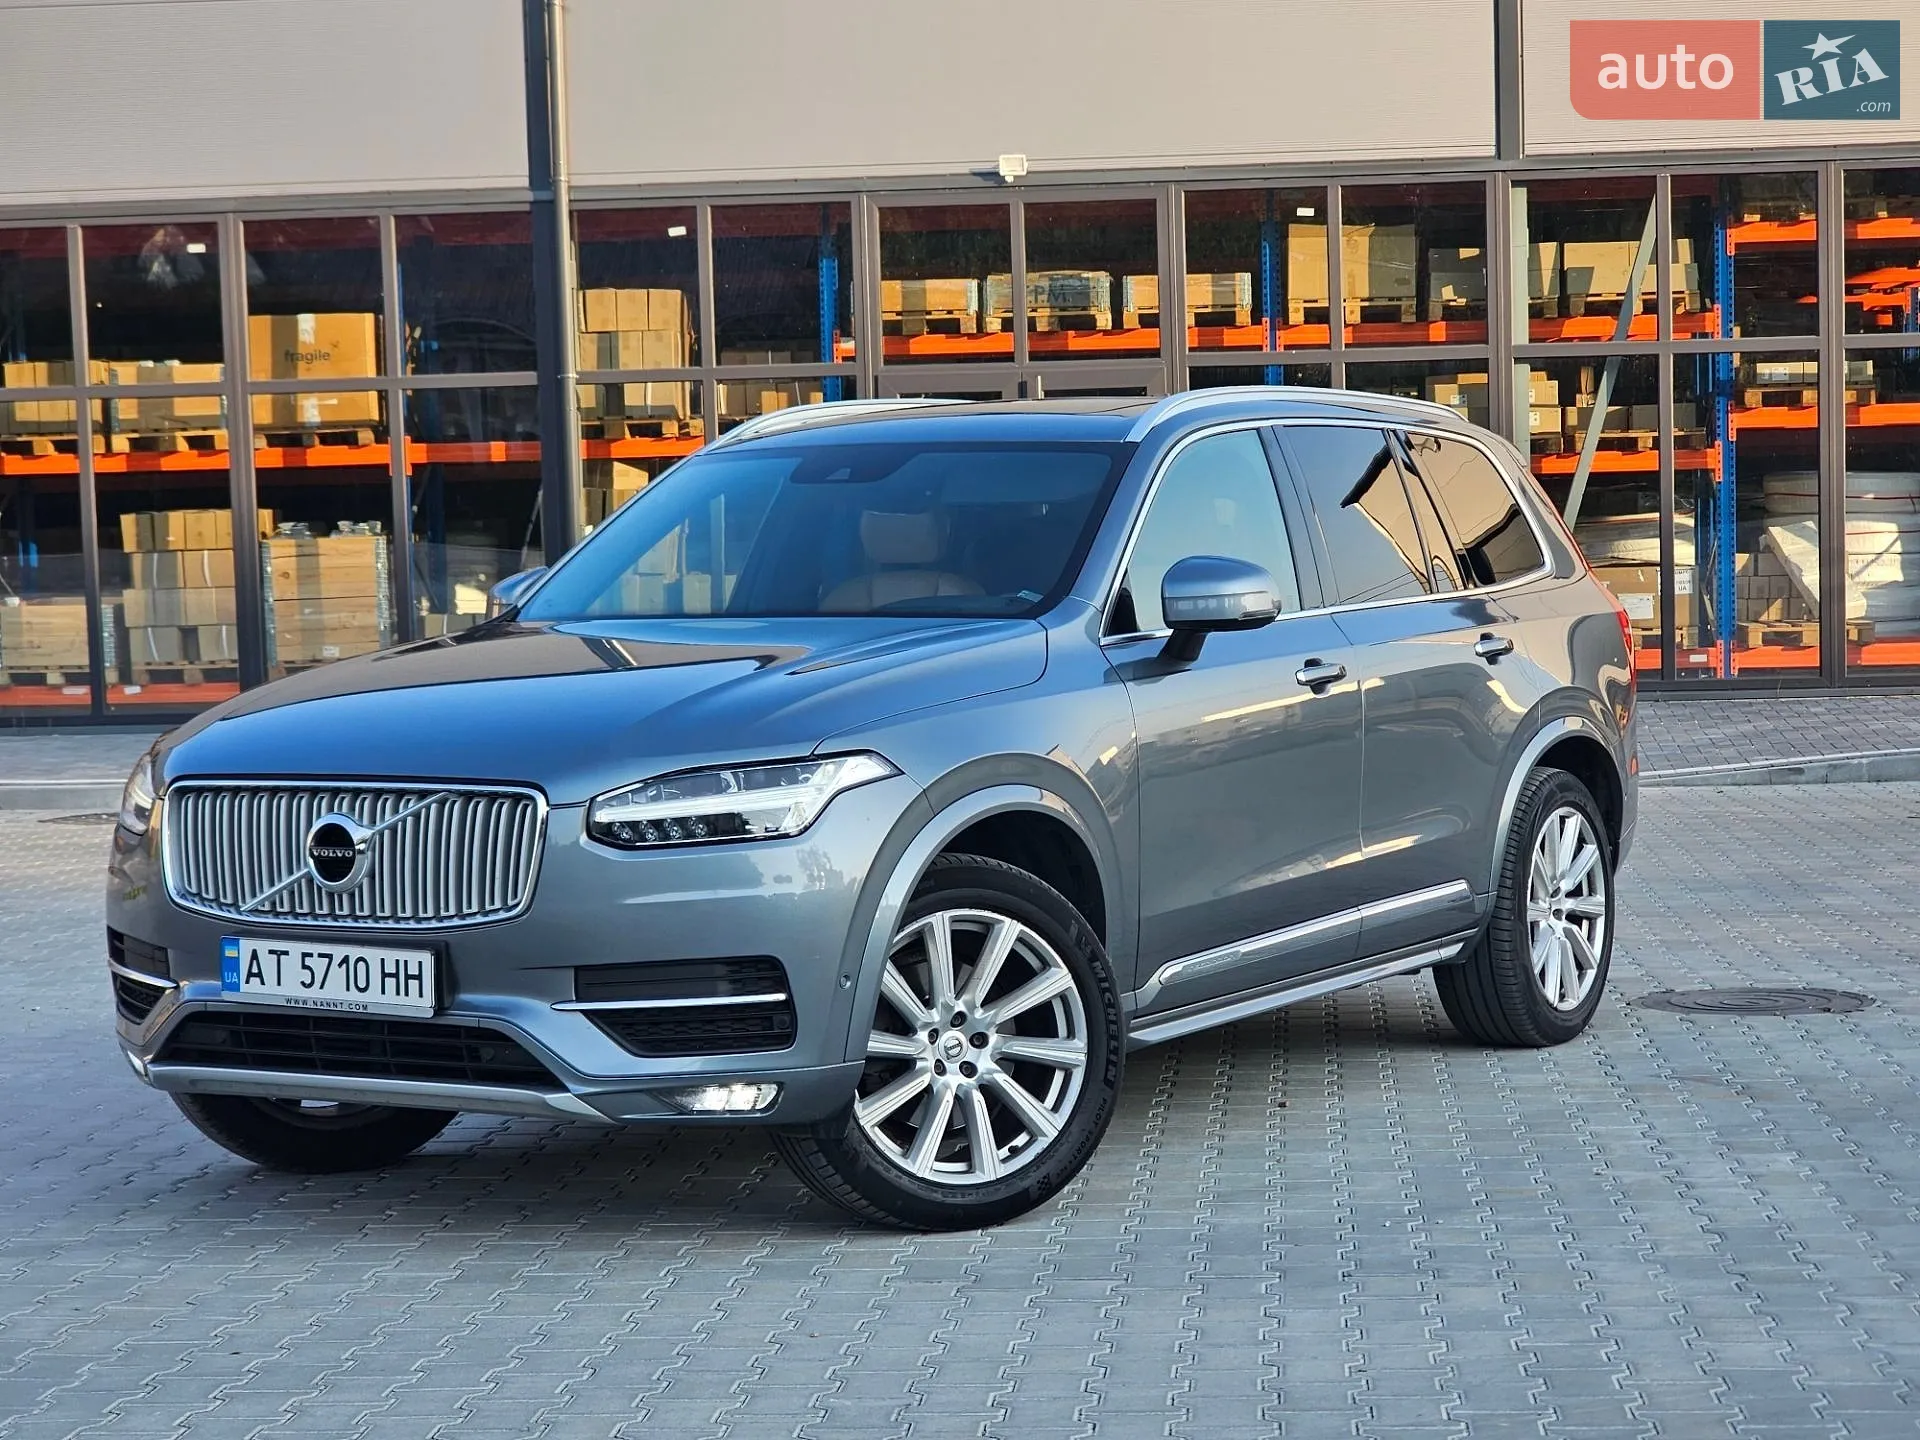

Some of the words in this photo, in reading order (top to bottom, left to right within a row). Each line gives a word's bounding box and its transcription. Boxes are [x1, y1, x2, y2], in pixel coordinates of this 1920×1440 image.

[284, 349, 331, 365] fragile
[312, 849, 354, 858] VOLVO
[224, 971, 239, 984] UA
[244, 948, 290, 987] AT
[300, 951, 370, 994] 5710
[380, 957, 424, 998] HH
[284, 997, 369, 1012] WWW.NANNT.COM
[1090, 959, 1120, 1082] MICHELIN
[1092, 1097, 1108, 1128] PILOT
